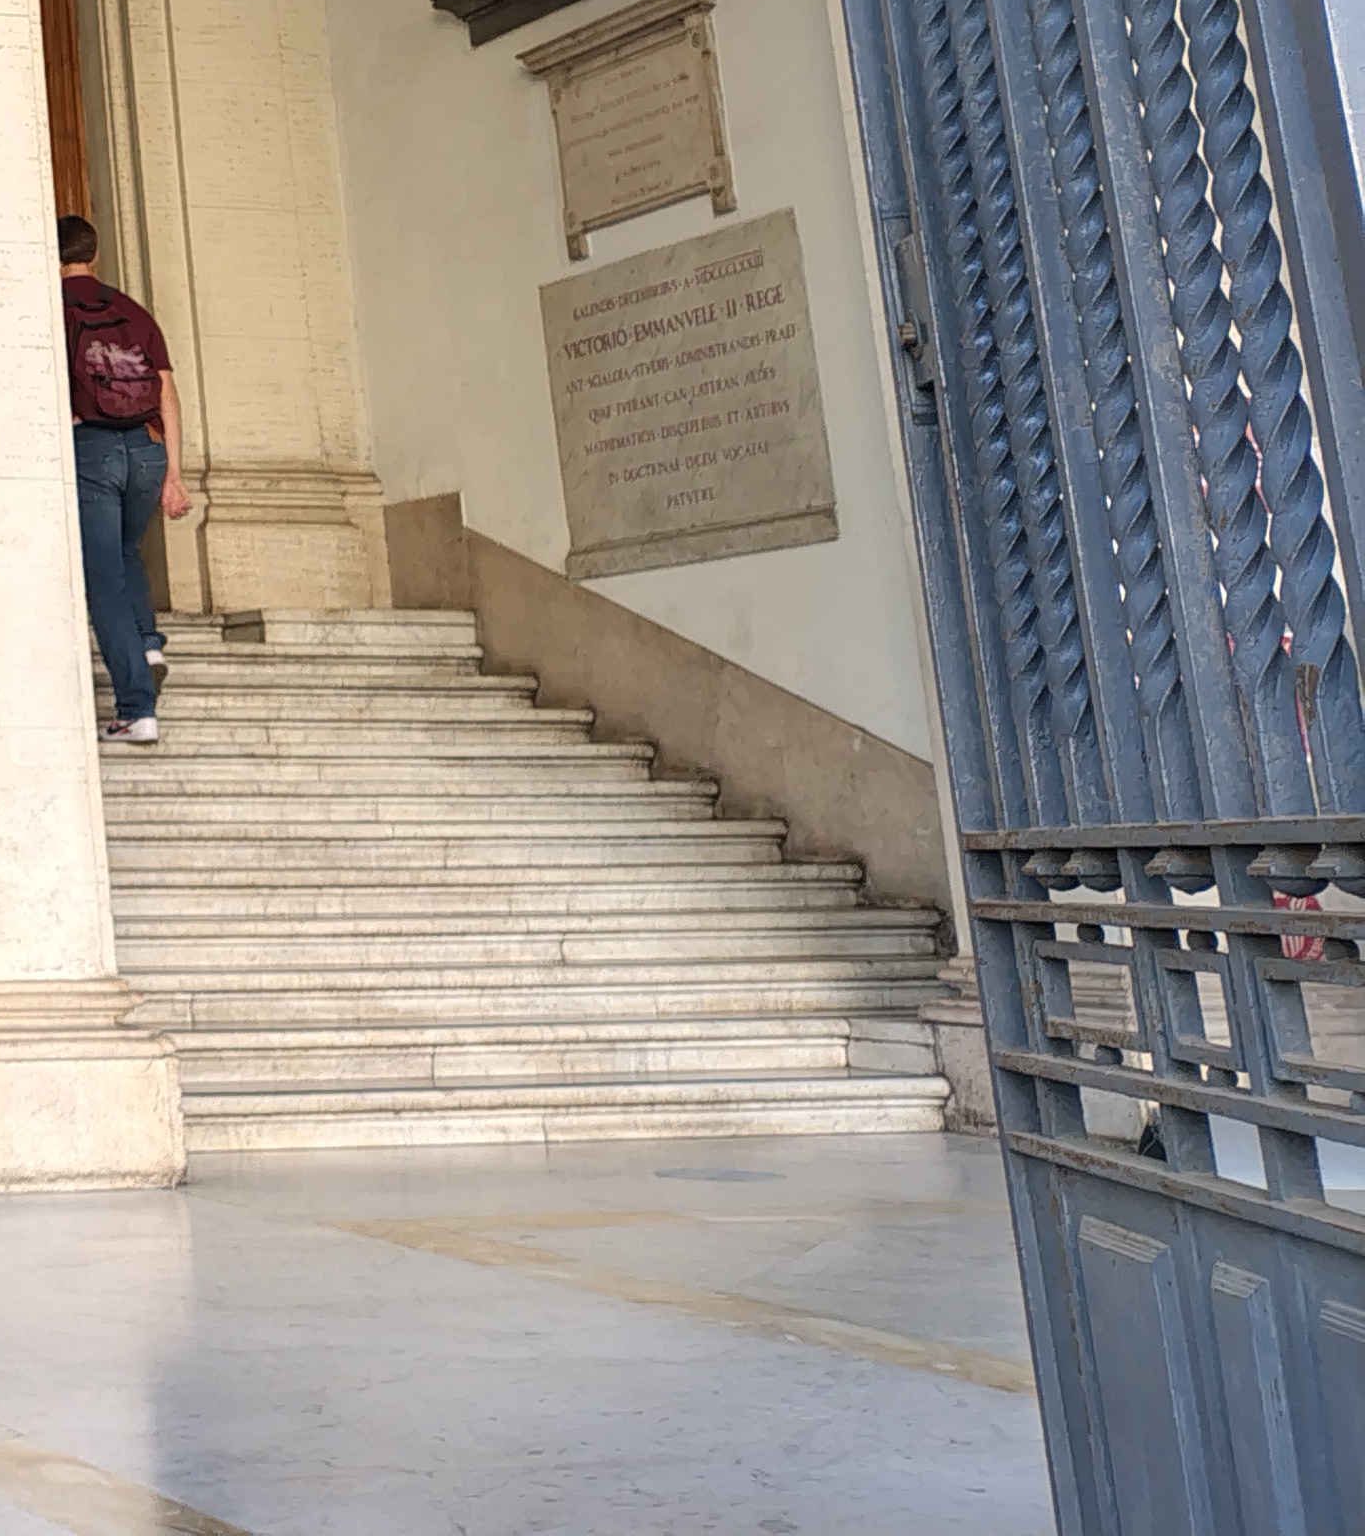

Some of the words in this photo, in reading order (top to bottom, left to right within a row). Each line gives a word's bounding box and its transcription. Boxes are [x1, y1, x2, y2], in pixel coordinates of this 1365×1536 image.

[564, 329, 628, 360] VICTORIO
[633, 303, 718, 343] EMMANVELE
[746, 284, 785, 312] REGE
